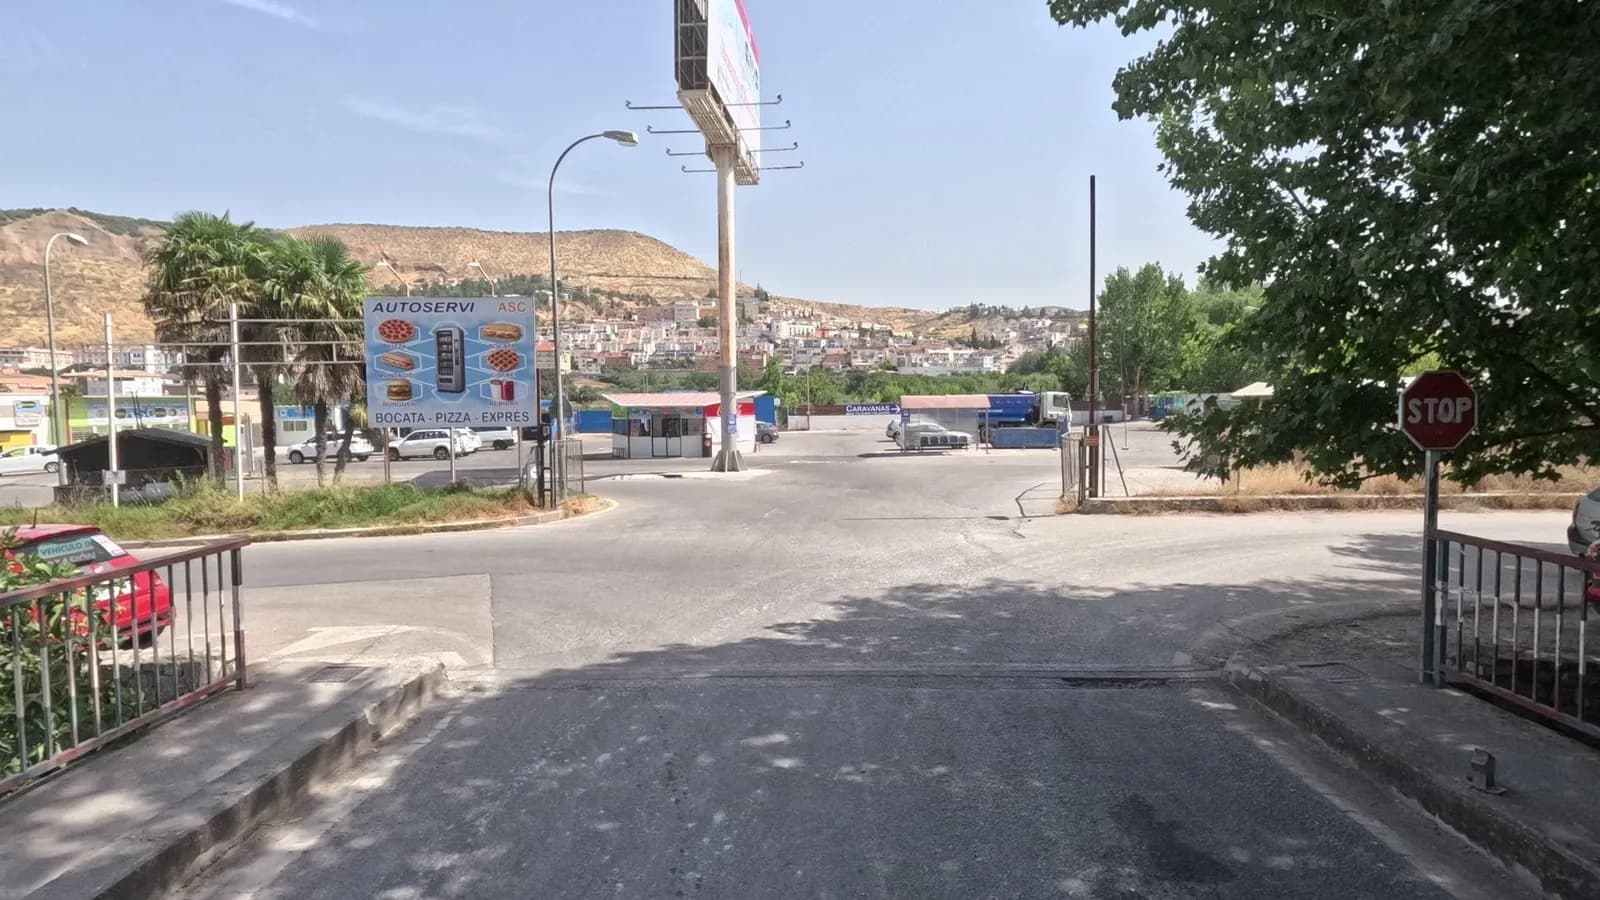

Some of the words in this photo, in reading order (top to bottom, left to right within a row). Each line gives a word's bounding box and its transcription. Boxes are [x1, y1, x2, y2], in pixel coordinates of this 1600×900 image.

[372, 302, 475, 313] AUTOSERVI
[498, 302, 526, 312] ASC
[1407, 397, 1472, 424] STOP
[375, 412, 425, 424] BOCATA
[435, 413, 471, 423] PIZZA
